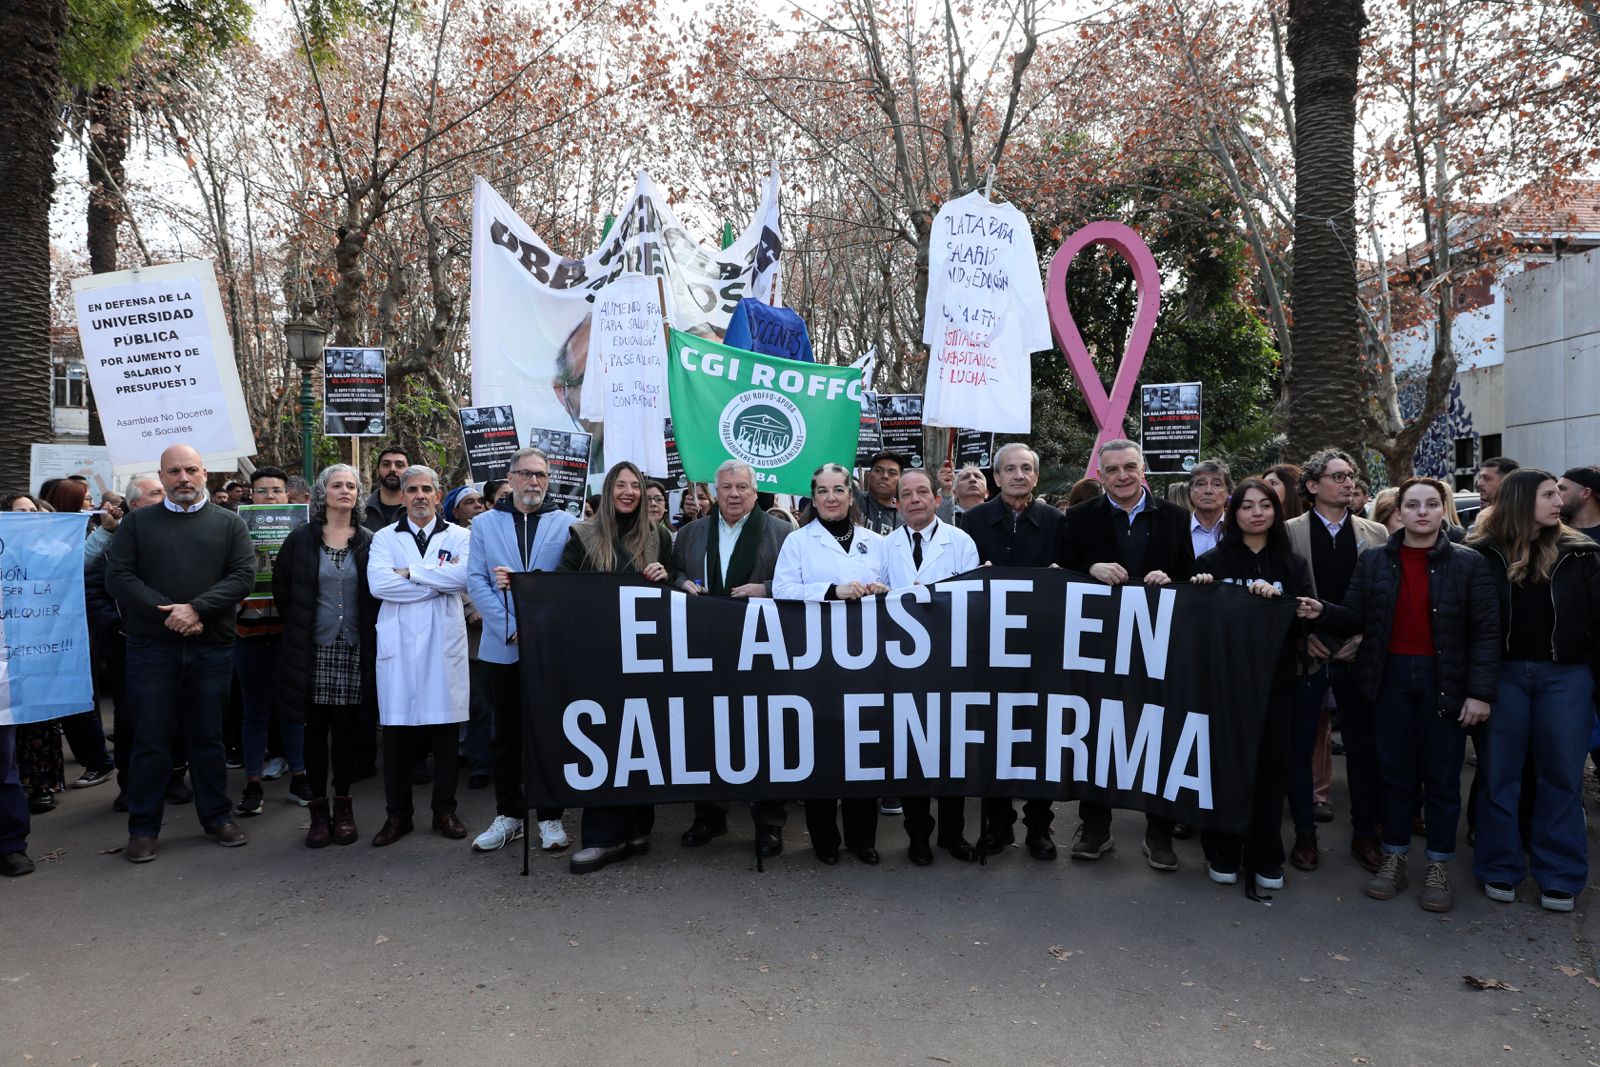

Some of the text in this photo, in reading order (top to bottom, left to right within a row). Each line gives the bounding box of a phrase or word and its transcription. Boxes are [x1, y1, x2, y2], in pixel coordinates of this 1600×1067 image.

[989, 216, 1014, 244] PARA
[88, 292, 192, 313] EN DEFENSA DE LA
[92, 308, 194, 330] UNIVERSIDAD
[113, 330, 180, 347] PÚBLICA
[100, 348, 200, 367] POR AUMENTO DE
[680, 346, 740, 381] CGI
[123, 364, 182, 379] SALARIO Y
[950, 369, 987, 386] LUCHA
[117, 408, 214, 427] Asamblea No Docente
[141, 425, 193, 438] de Sociales
[2, 583, 52, 596] SER LA
[620, 579, 1176, 680] EL AJUSTE EN
[562, 692, 1214, 810] SALUD ENFERMA
